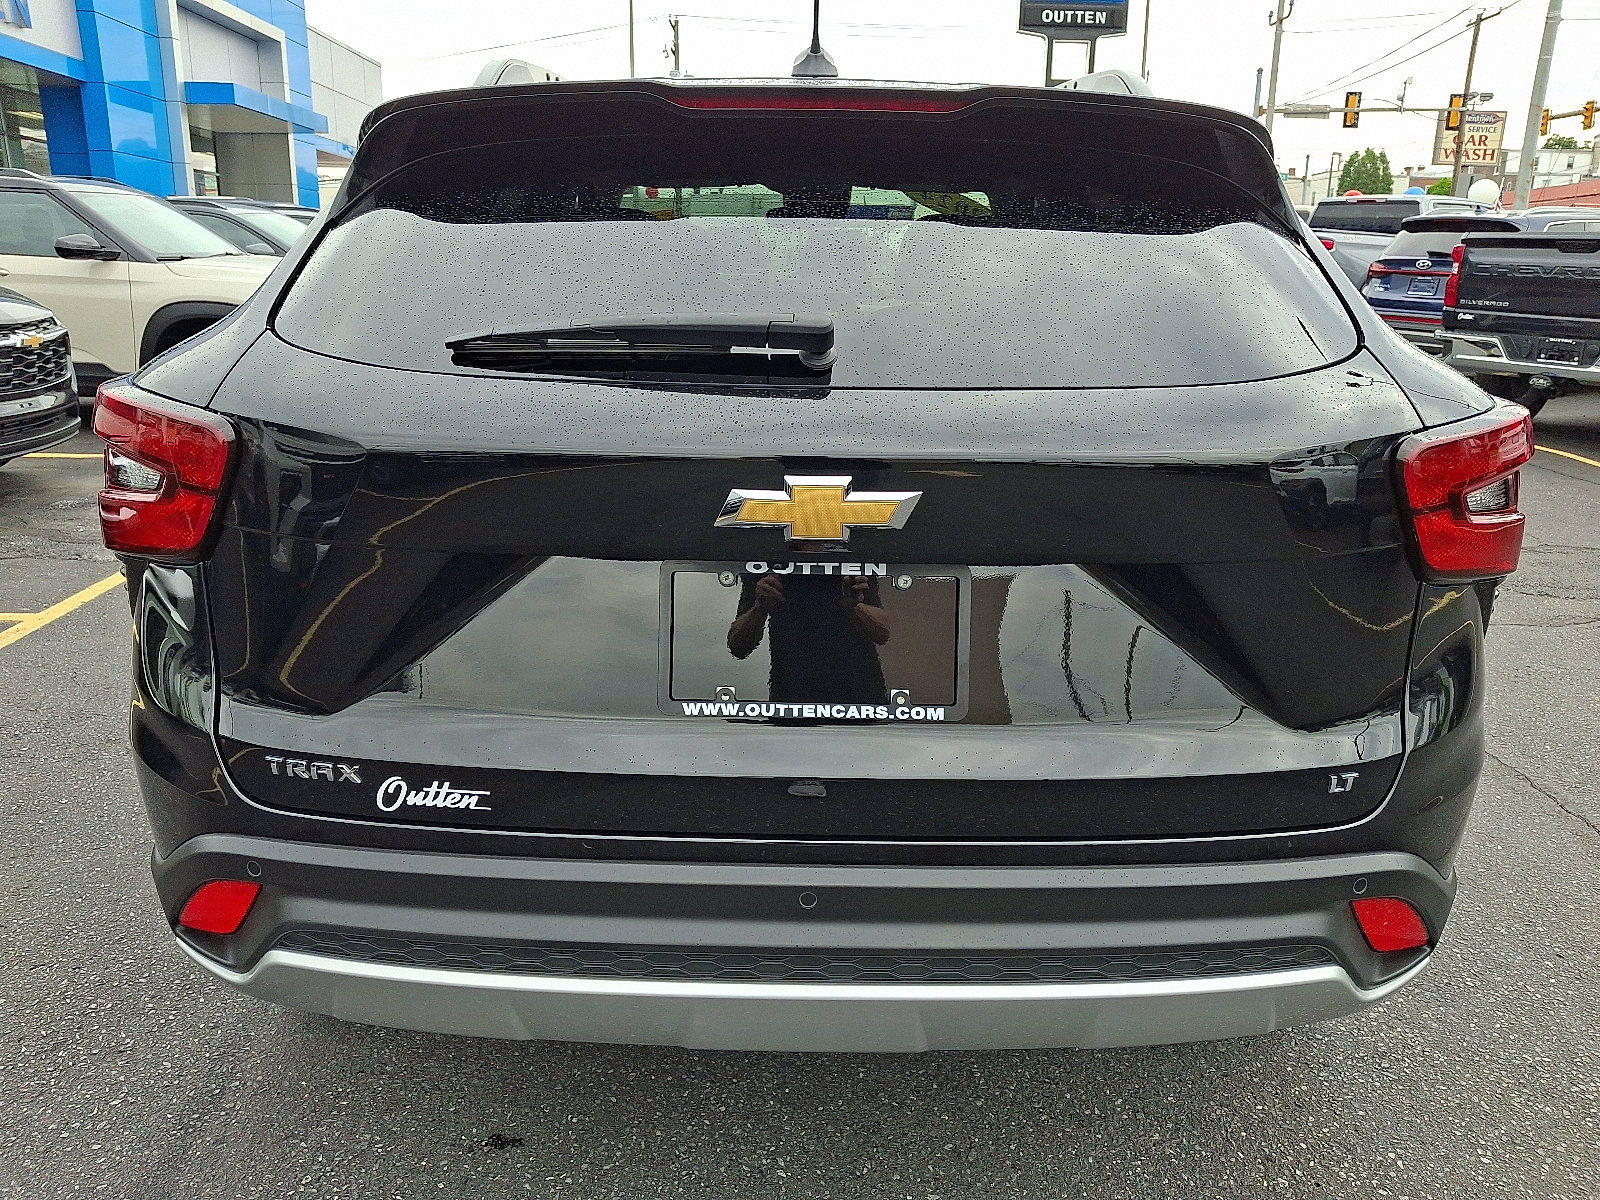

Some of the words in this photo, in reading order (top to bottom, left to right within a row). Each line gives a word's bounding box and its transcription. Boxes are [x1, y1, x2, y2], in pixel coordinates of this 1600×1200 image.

[1041, 9, 1107, 24] OUTTEN
[1444, 148, 1496, 161] WASH
[745, 561, 887, 576] OUTTEN
[681, 702, 946, 721] WWW.OUTTENCARS.COM
[264, 755, 362, 784] TRAX
[1328, 771, 1360, 793] LT
[376, 776, 492, 812] Outten
